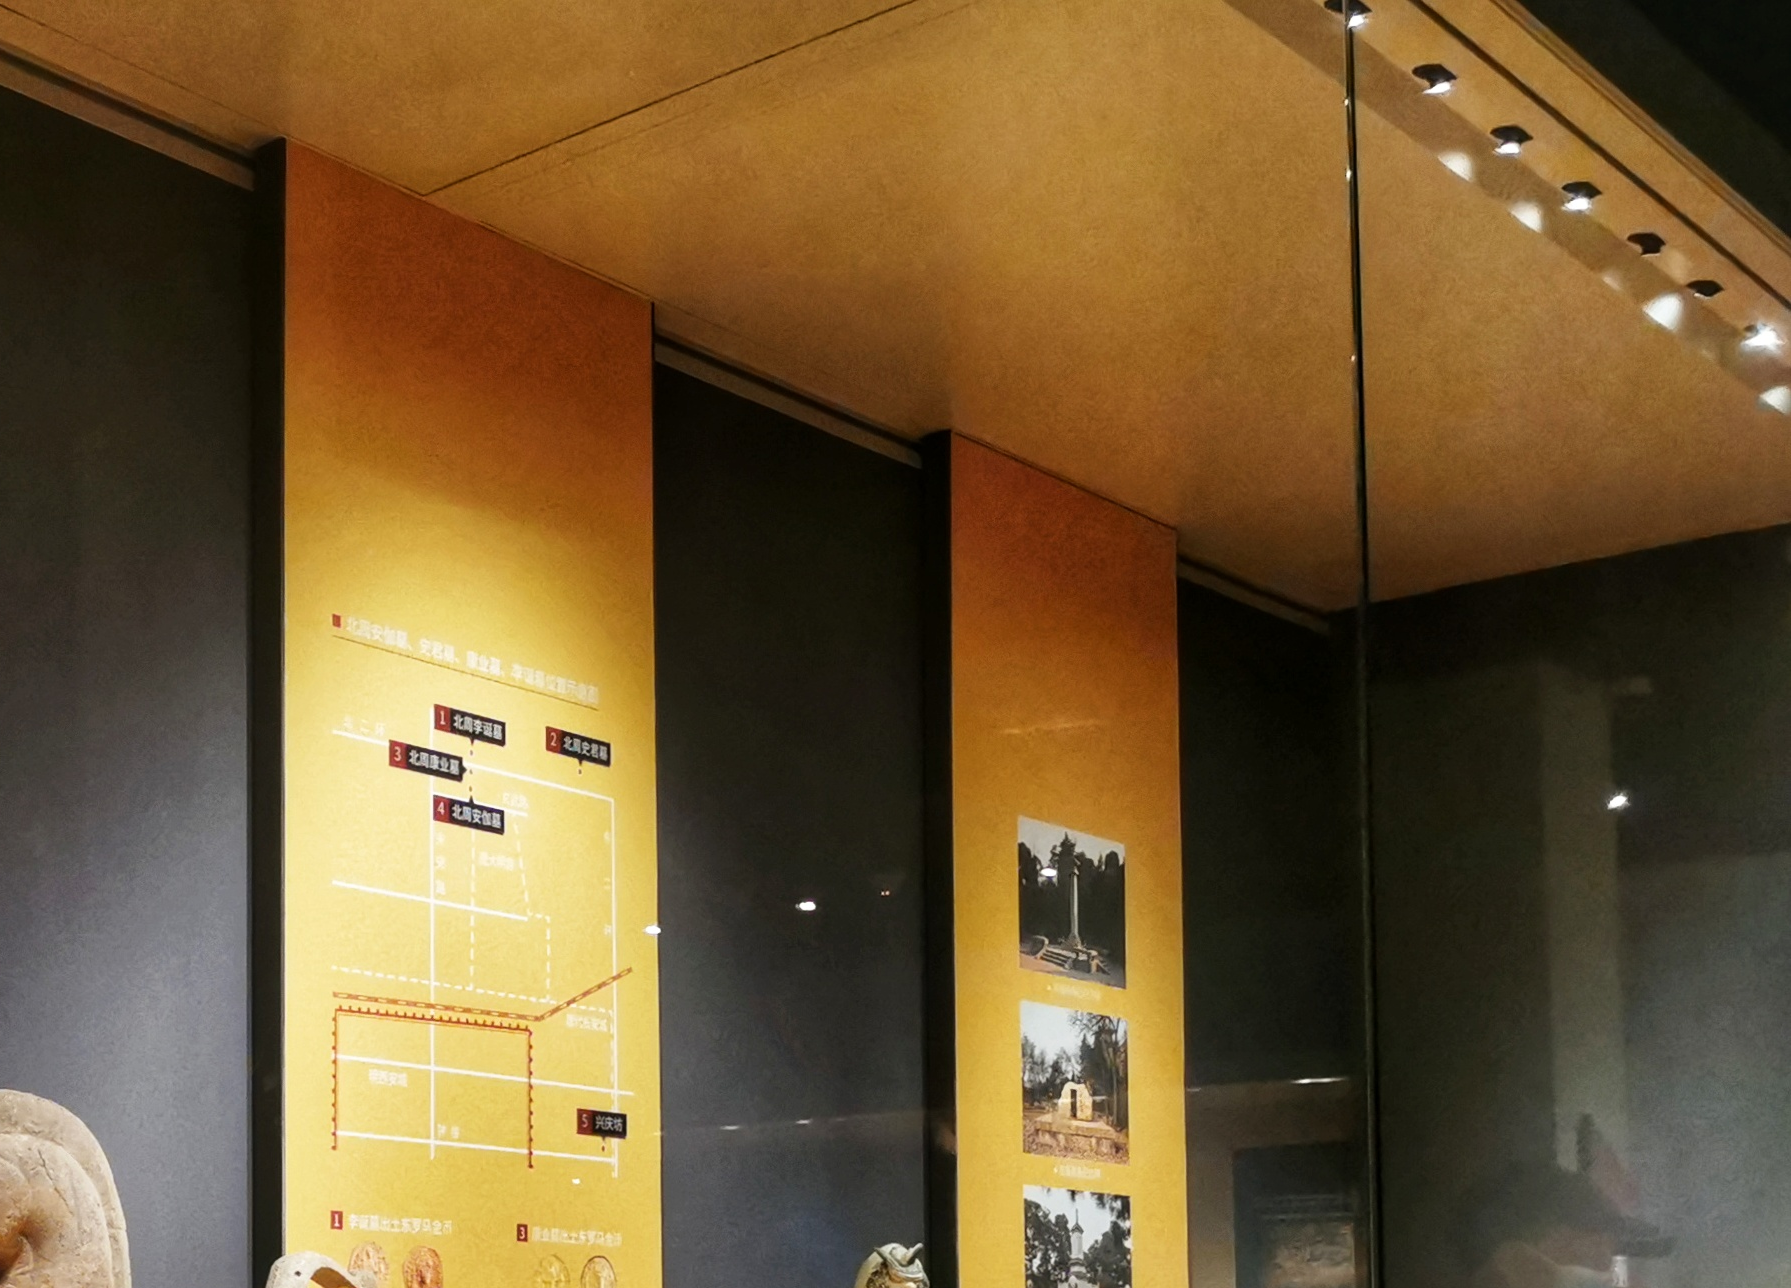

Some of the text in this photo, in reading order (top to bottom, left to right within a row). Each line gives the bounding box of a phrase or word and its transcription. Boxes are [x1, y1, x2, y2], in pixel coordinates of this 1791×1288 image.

[440, 710, 503, 741] 1 北周李诞墓
[550, 732, 557, 747] 2
[393, 746, 460, 776] 3 北周康业墓
[437, 801, 502, 829] 4 北周安伽墓
[582, 1113, 623, 1132] 5 兴庆坊
[334, 1213, 341, 1227] 1
[519, 1227, 526, 1240] 3
